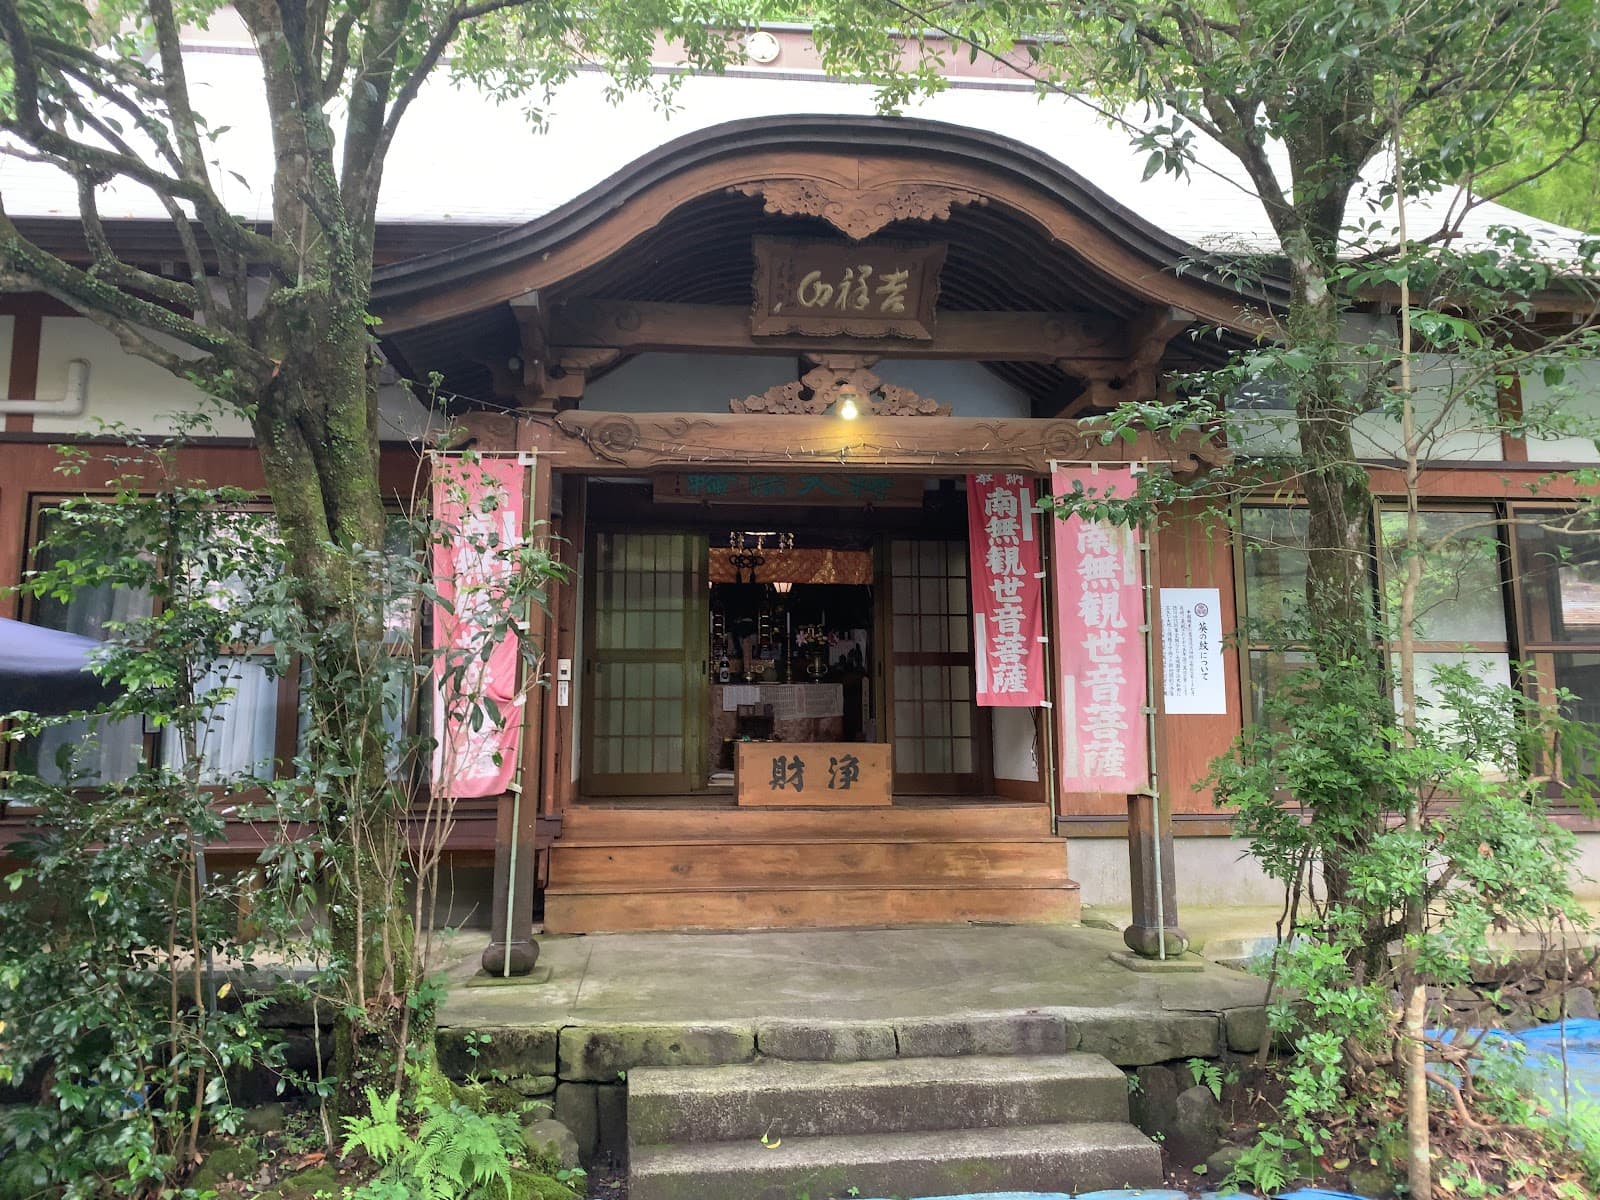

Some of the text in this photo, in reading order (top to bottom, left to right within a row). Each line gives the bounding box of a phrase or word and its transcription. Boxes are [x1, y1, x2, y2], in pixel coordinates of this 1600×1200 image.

[985, 486, 1028, 693] 南無観世音菩薩
[1076, 518, 1128, 778] 南無観世音菩薩
[769, 753, 859, 792] 浄財
